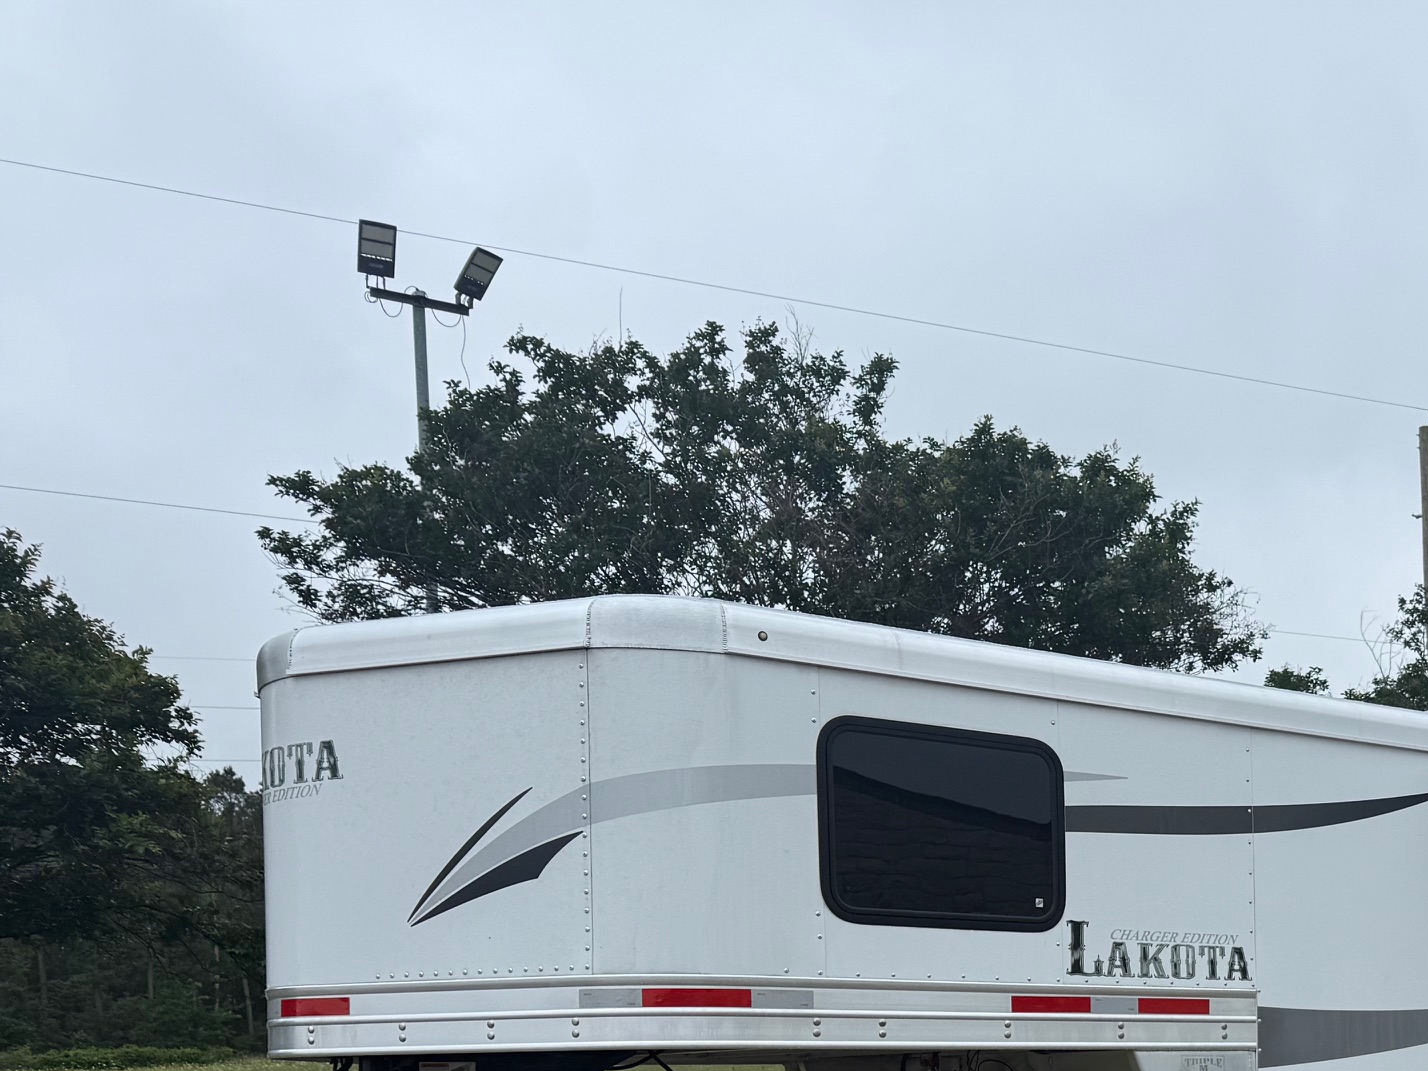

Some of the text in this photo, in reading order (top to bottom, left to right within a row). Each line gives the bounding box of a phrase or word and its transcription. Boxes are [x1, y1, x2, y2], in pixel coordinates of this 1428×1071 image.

[272, 783, 322, 803] EDITION
[1110, 928, 1239, 945] CHARGER EDITION
[1066, 919, 1253, 981] LAKOTA
